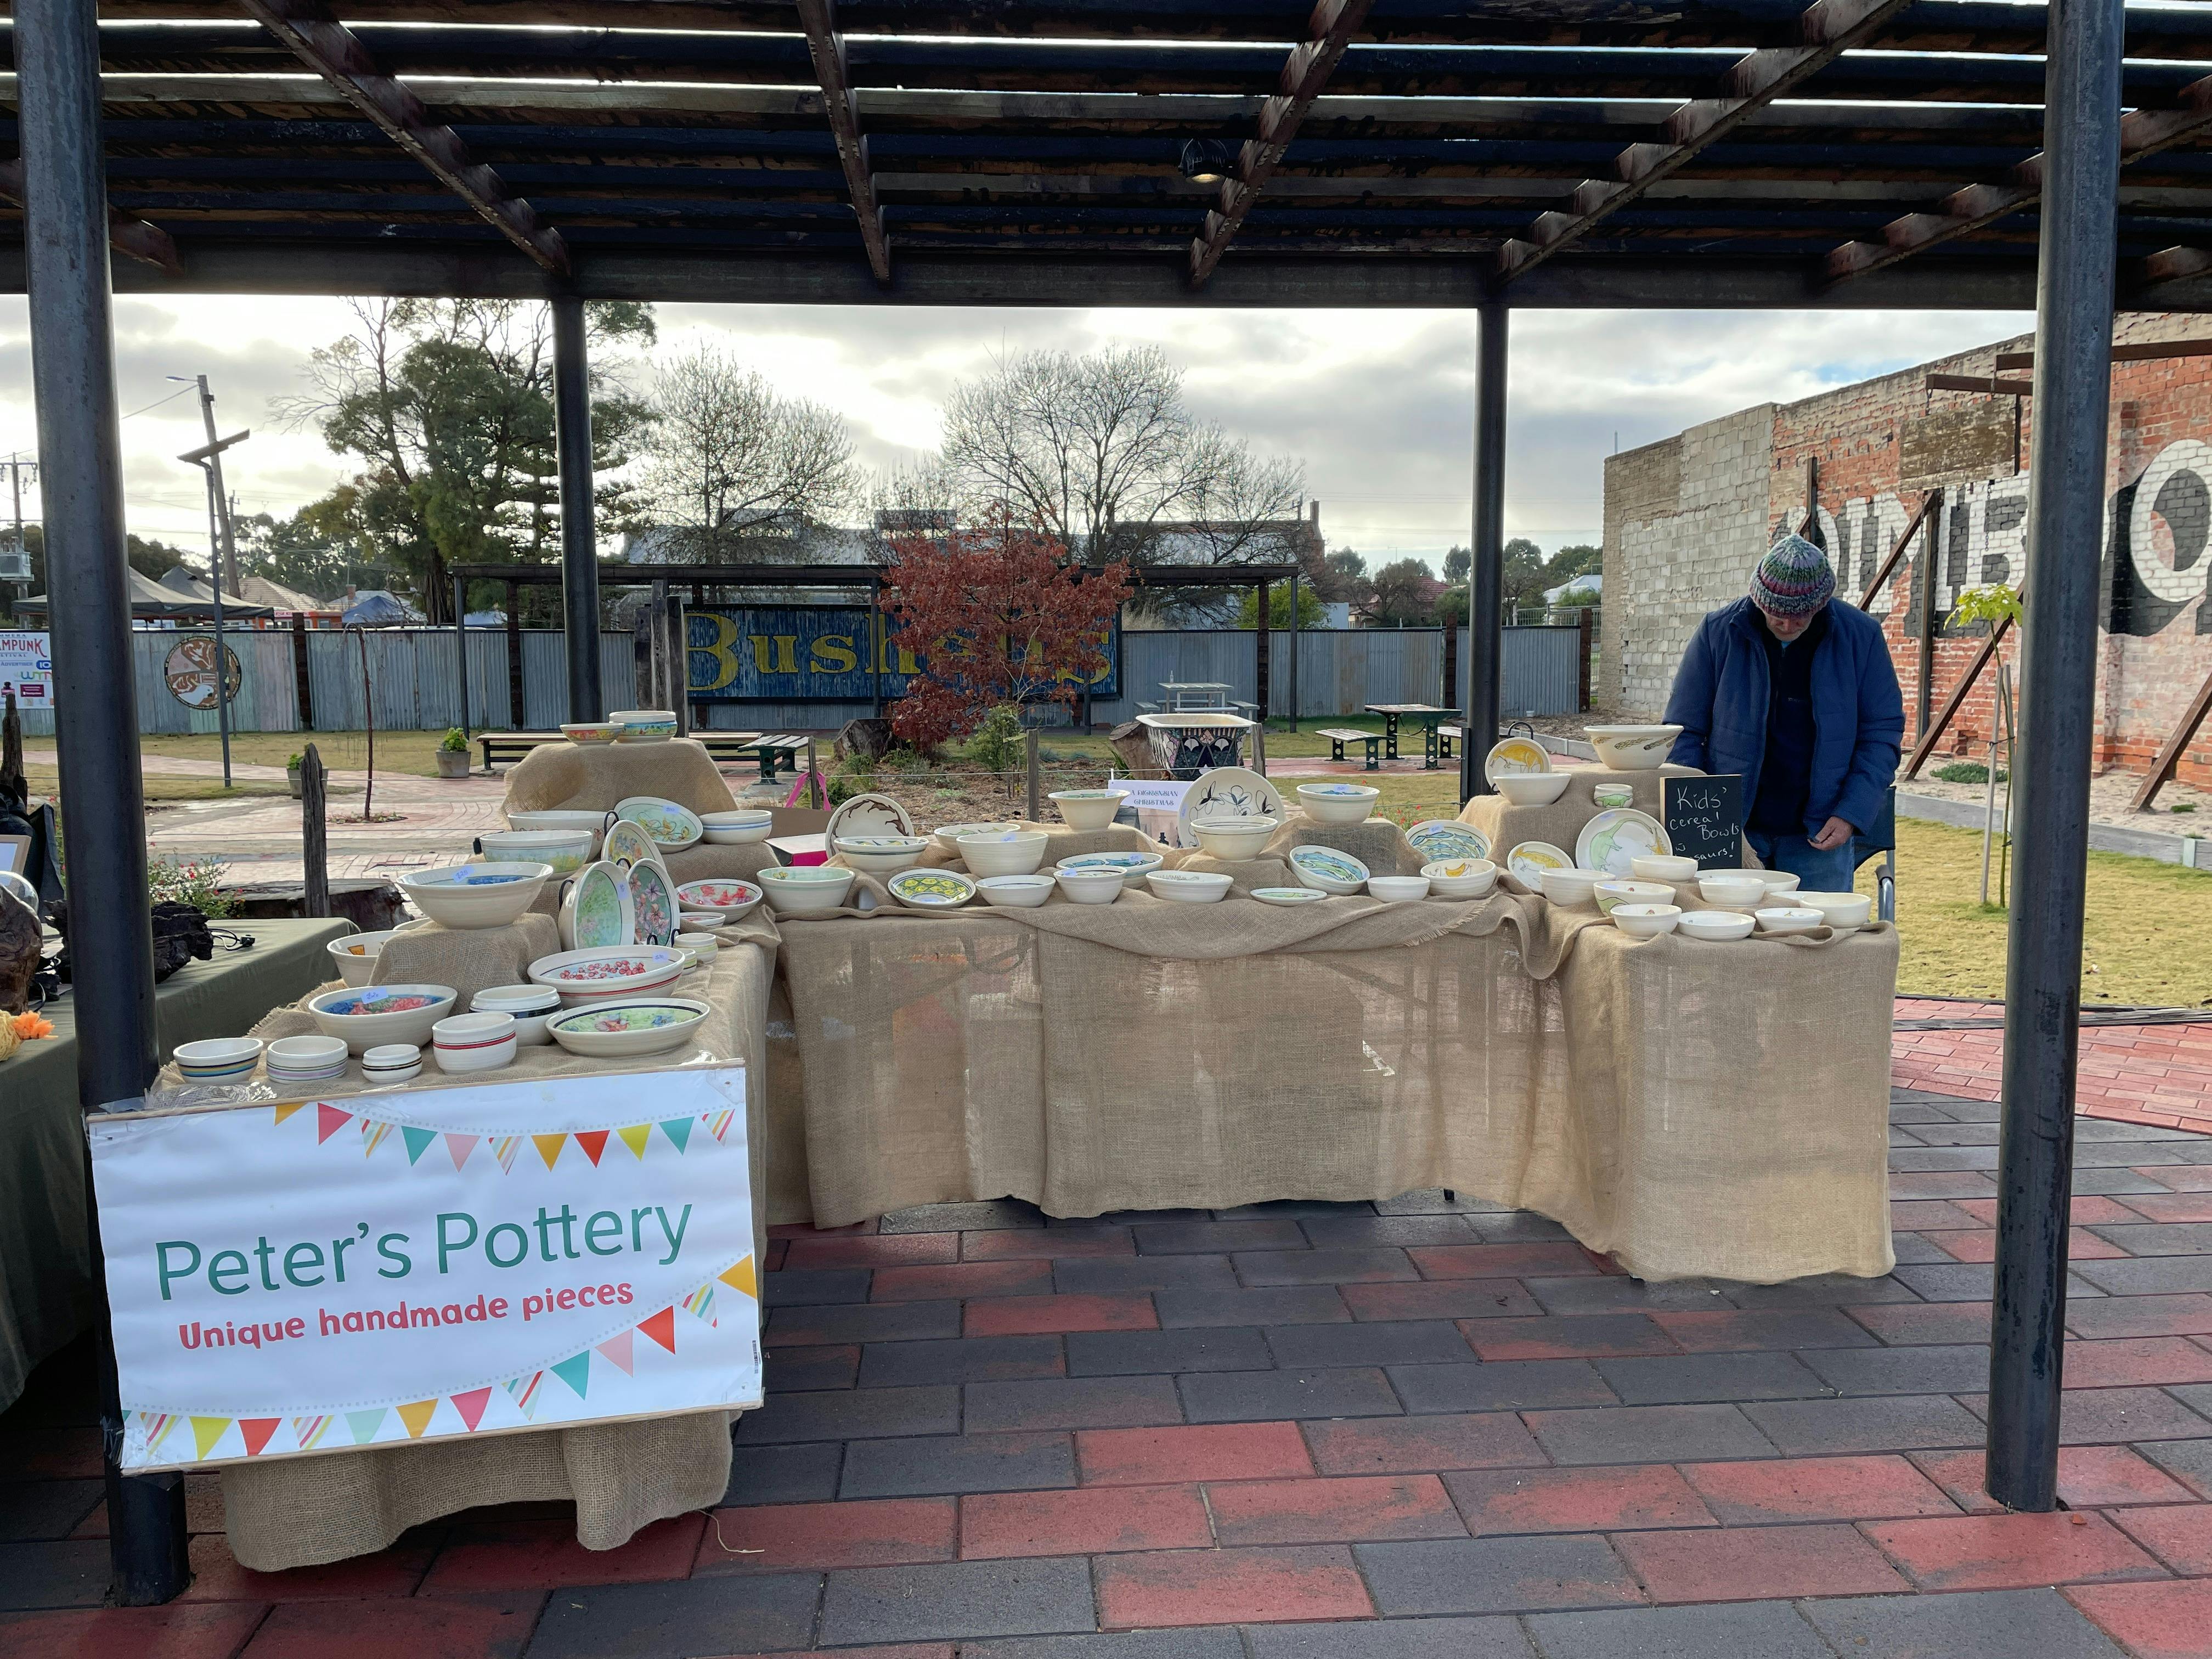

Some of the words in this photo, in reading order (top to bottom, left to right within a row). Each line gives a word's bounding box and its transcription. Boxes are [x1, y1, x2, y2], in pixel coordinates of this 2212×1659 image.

[0, 638, 47, 657] MPUNK
[685, 613, 1111, 691] Bushs
[437, 1204, 693, 1274] Pottery
[179, 1312, 305, 1350] Unique
[320, 1294, 509, 1336] handmade
[522, 1282, 634, 1321] pieces
